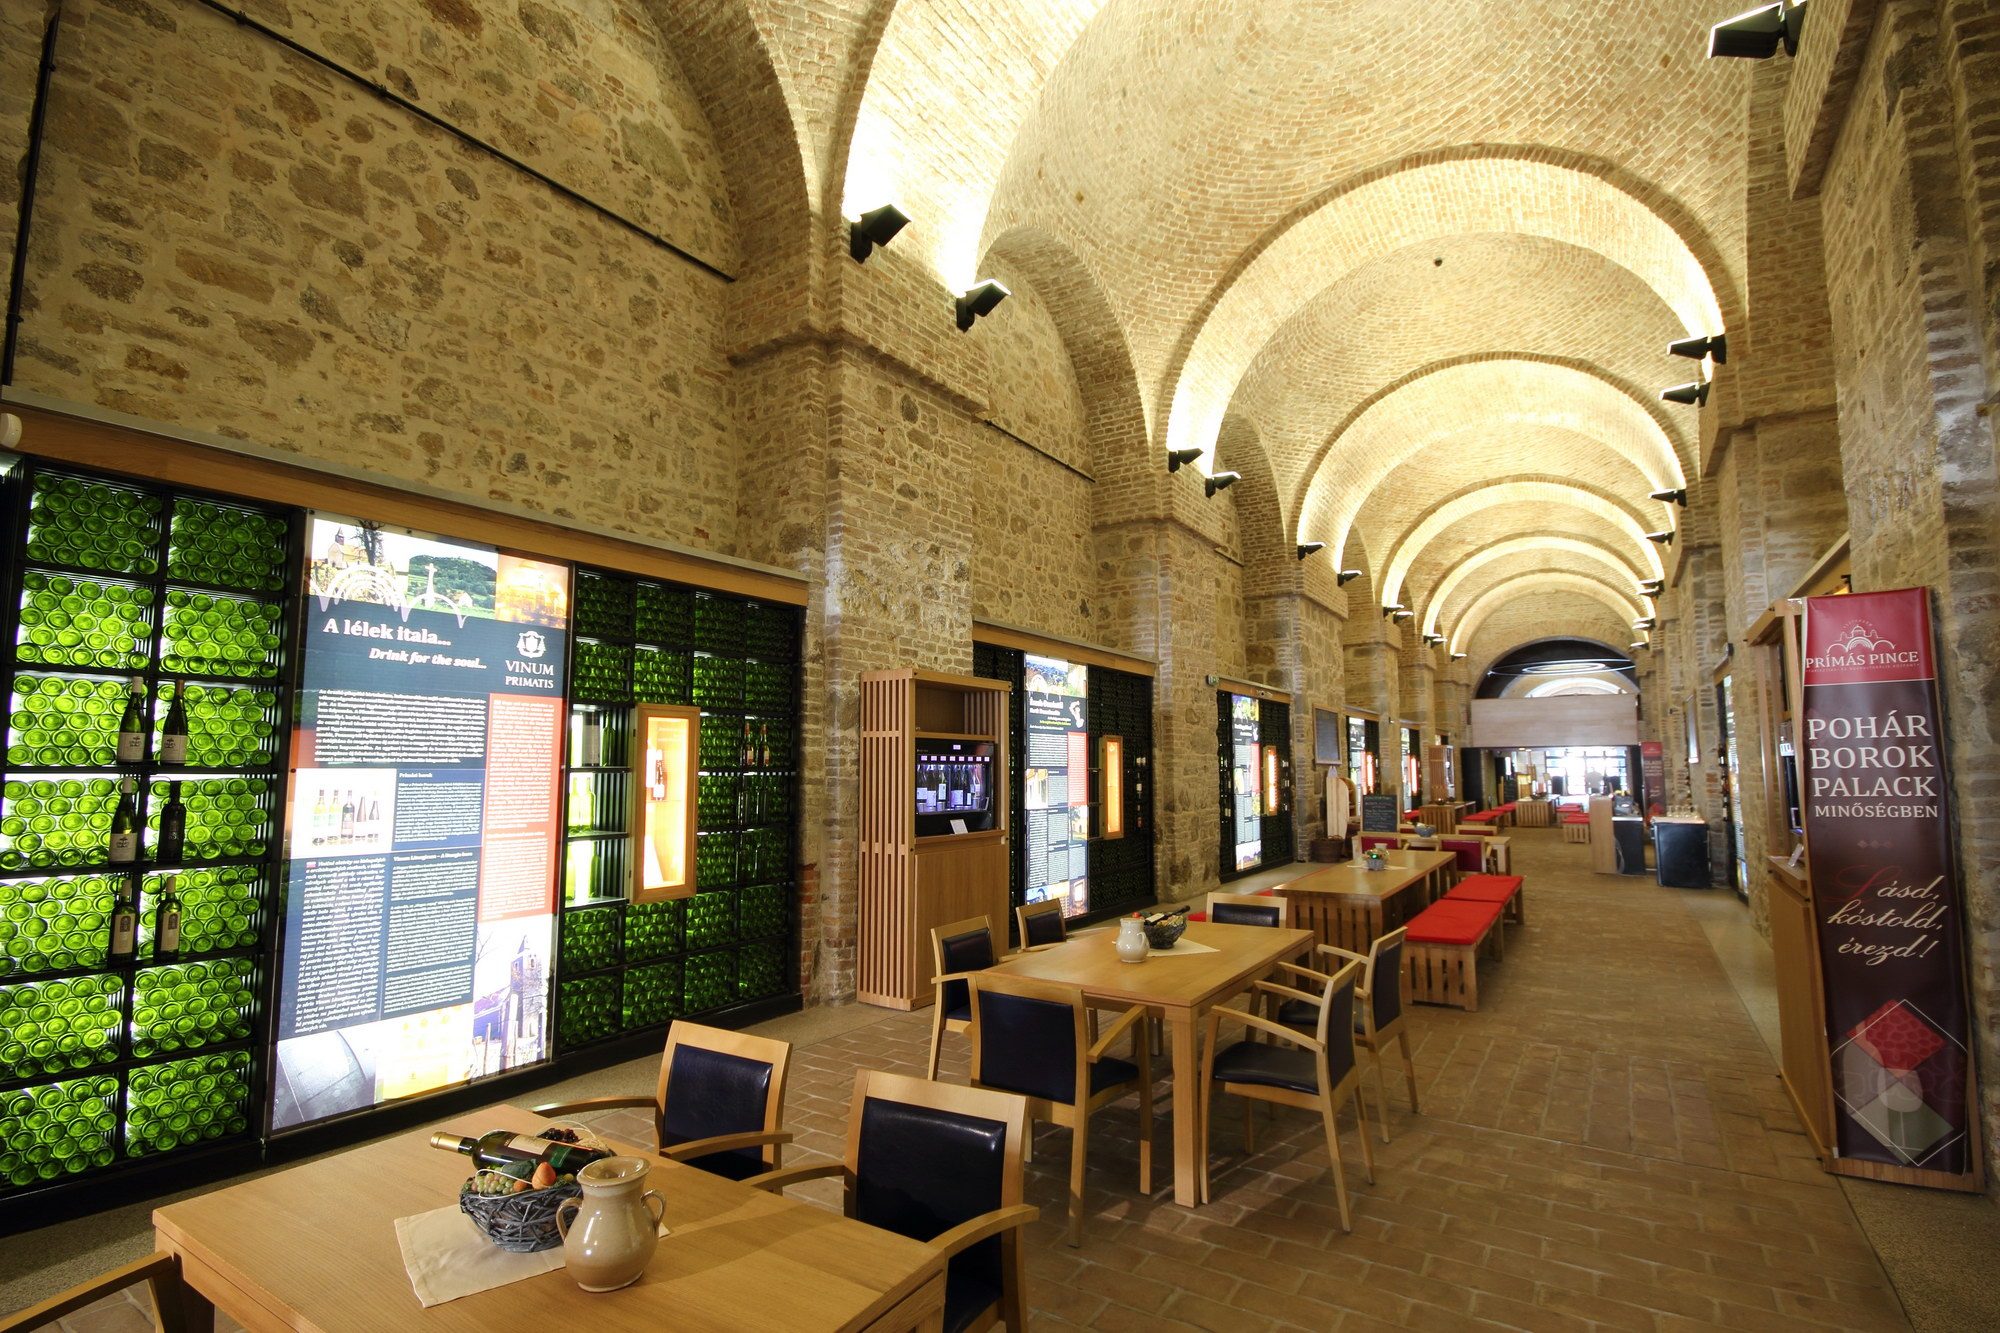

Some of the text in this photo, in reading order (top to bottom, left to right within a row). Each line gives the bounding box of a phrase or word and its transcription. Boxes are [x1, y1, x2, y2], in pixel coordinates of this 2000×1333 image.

[323, 617, 452, 646] A lélek itala...
[368, 647, 409, 663] Drink
[408, 651, 431, 666] for
[431, 653, 453, 667] the
[505, 659, 555, 677] VINUM
[1806, 652, 1867, 669] PRÍMÁS
[1868, 651, 1919, 666] PINCE
[504, 675, 555, 689] PRIMATIS
[1807, 709, 1932, 740] POHÁR
[1809, 745, 1935, 770] BOROK
[1812, 776, 1938, 798] PALACK
[1814, 802, 1939, 818] MINŐSÉGBEN
[1827, 899, 1949, 930] kóstold,
[1838, 934, 1940, 966] érezd!
